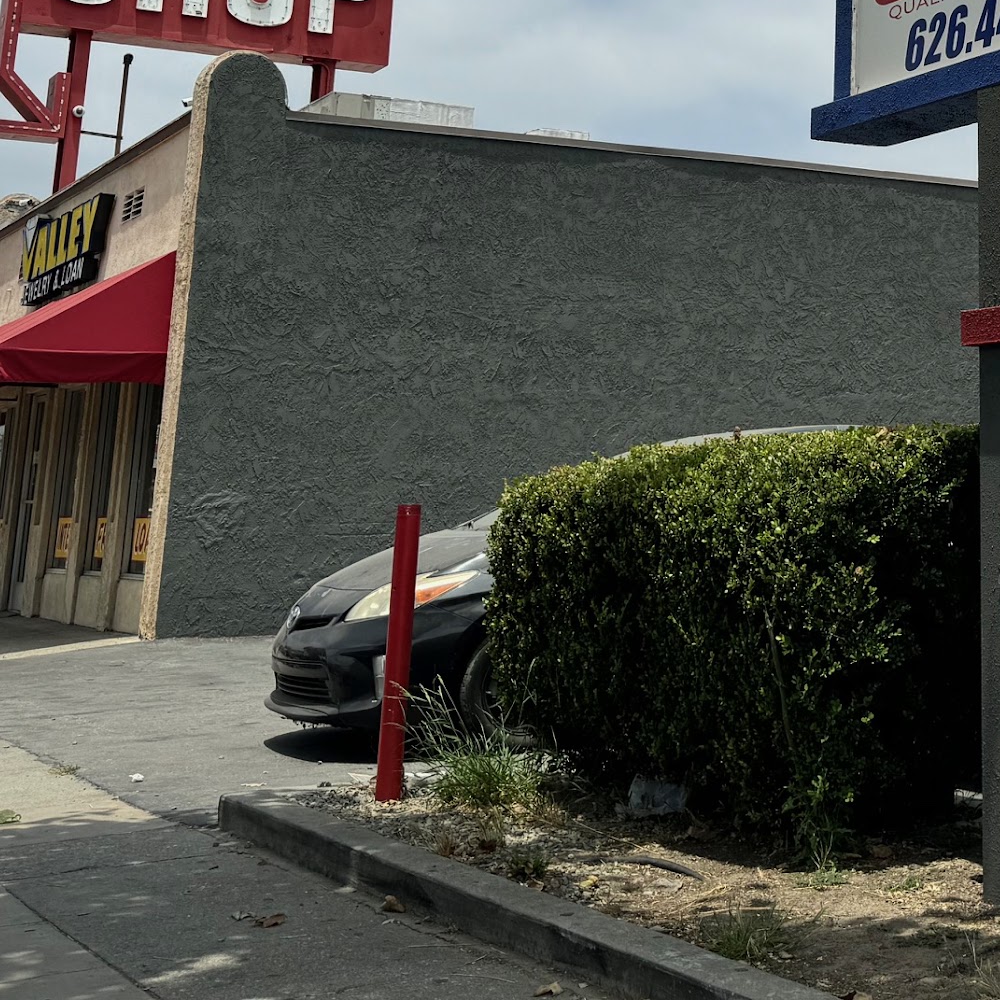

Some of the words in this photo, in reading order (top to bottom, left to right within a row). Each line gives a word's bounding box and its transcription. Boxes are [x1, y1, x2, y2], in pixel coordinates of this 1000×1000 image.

[23, 195, 99, 281] VALLEY
[22, 272, 52, 304] EWELRY
[61, 257, 84, 286] LOAN
